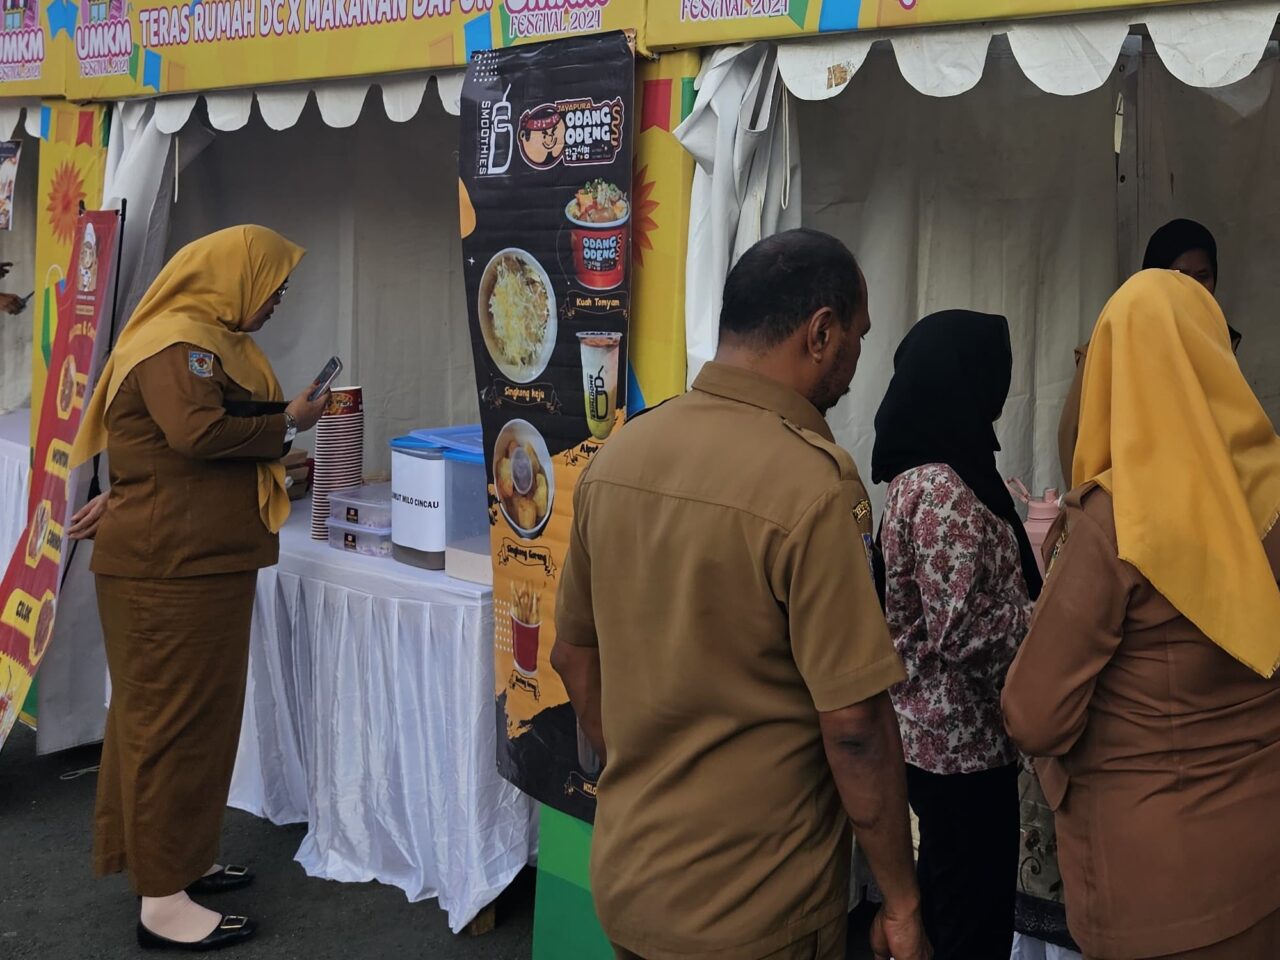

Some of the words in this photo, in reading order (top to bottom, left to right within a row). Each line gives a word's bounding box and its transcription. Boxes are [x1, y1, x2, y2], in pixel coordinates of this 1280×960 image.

[140, 5, 191, 48] TERAS
[510, 12, 567, 37] FESTIVAL
[570, 9, 600, 30] 2024
[77, 19, 132, 60] UMKM
[556, 102, 592, 113] JAYAPURA
[565, 106, 611, 128] ODANG
[479, 100, 491, 175] SMOOTHIES
[565, 124, 611, 145] ODENG
[582, 236, 617, 249] ODANG
[583, 248, 616, 261] ODENG
[414, 498, 440, 509] CINCAU
